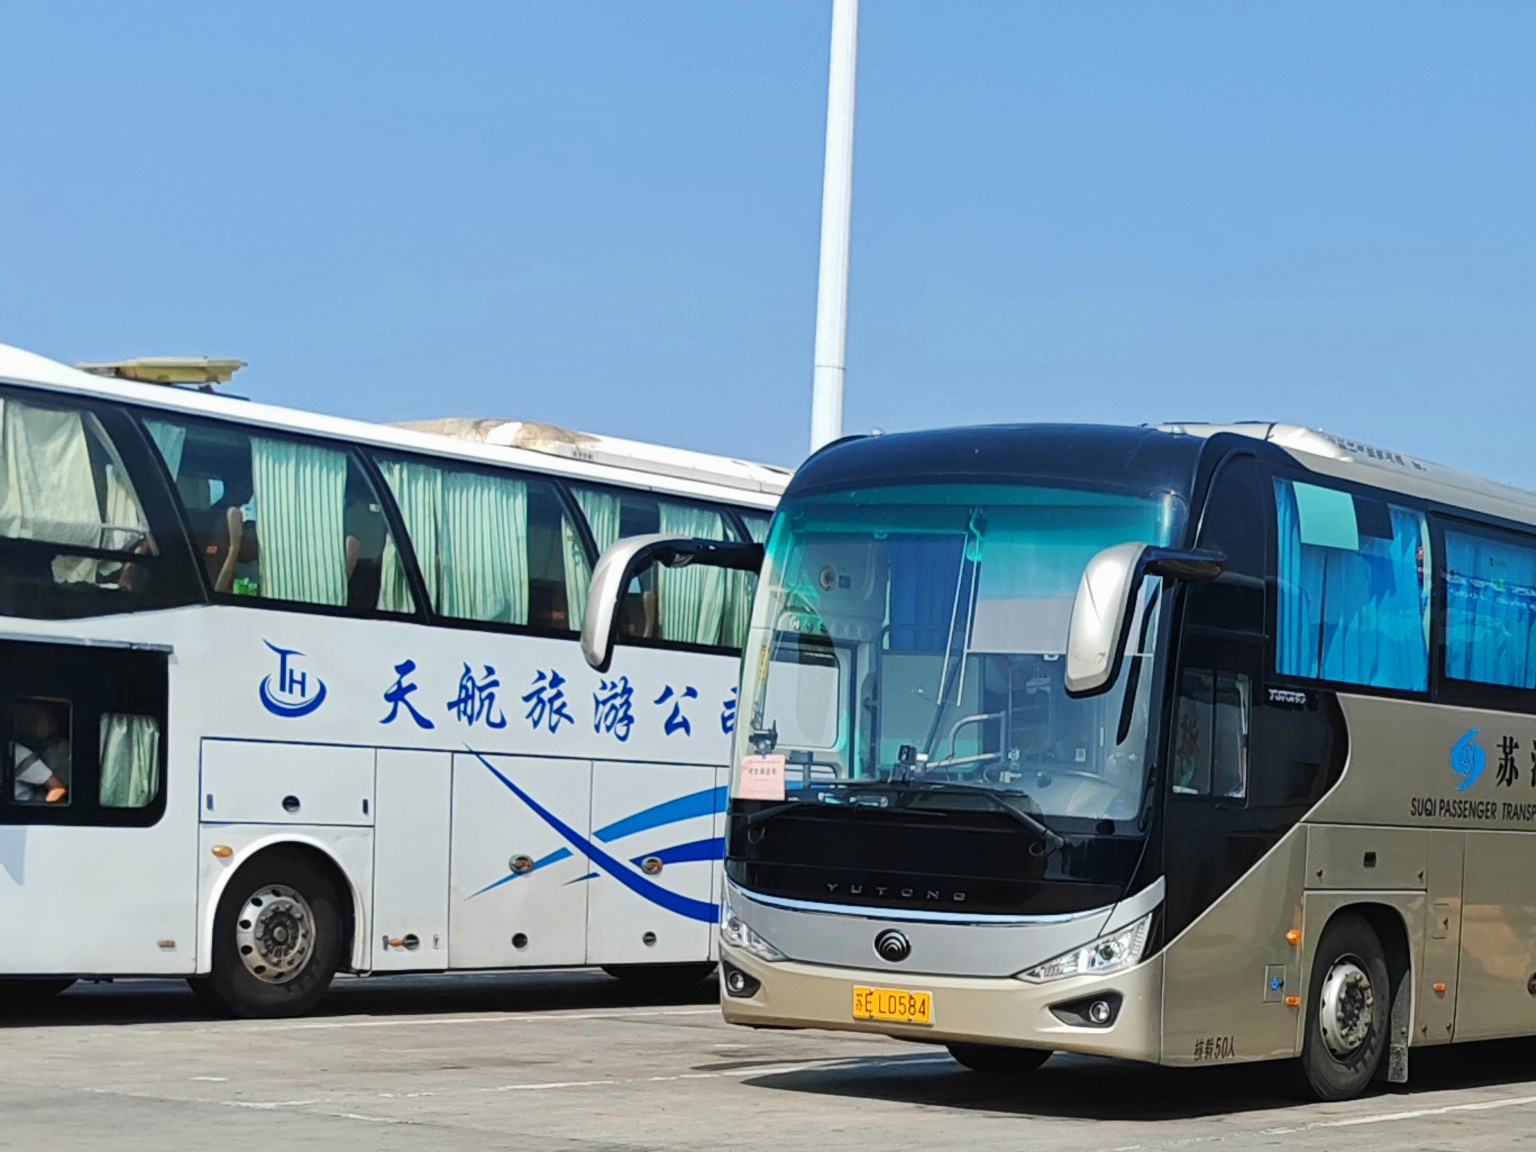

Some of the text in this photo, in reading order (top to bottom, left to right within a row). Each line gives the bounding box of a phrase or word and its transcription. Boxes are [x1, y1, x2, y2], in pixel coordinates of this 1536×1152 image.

[1410, 797, 1437, 817] SUQI
[1438, 798, 1498, 820] PASSENGER
[826, 882, 966, 901] YUTONG
